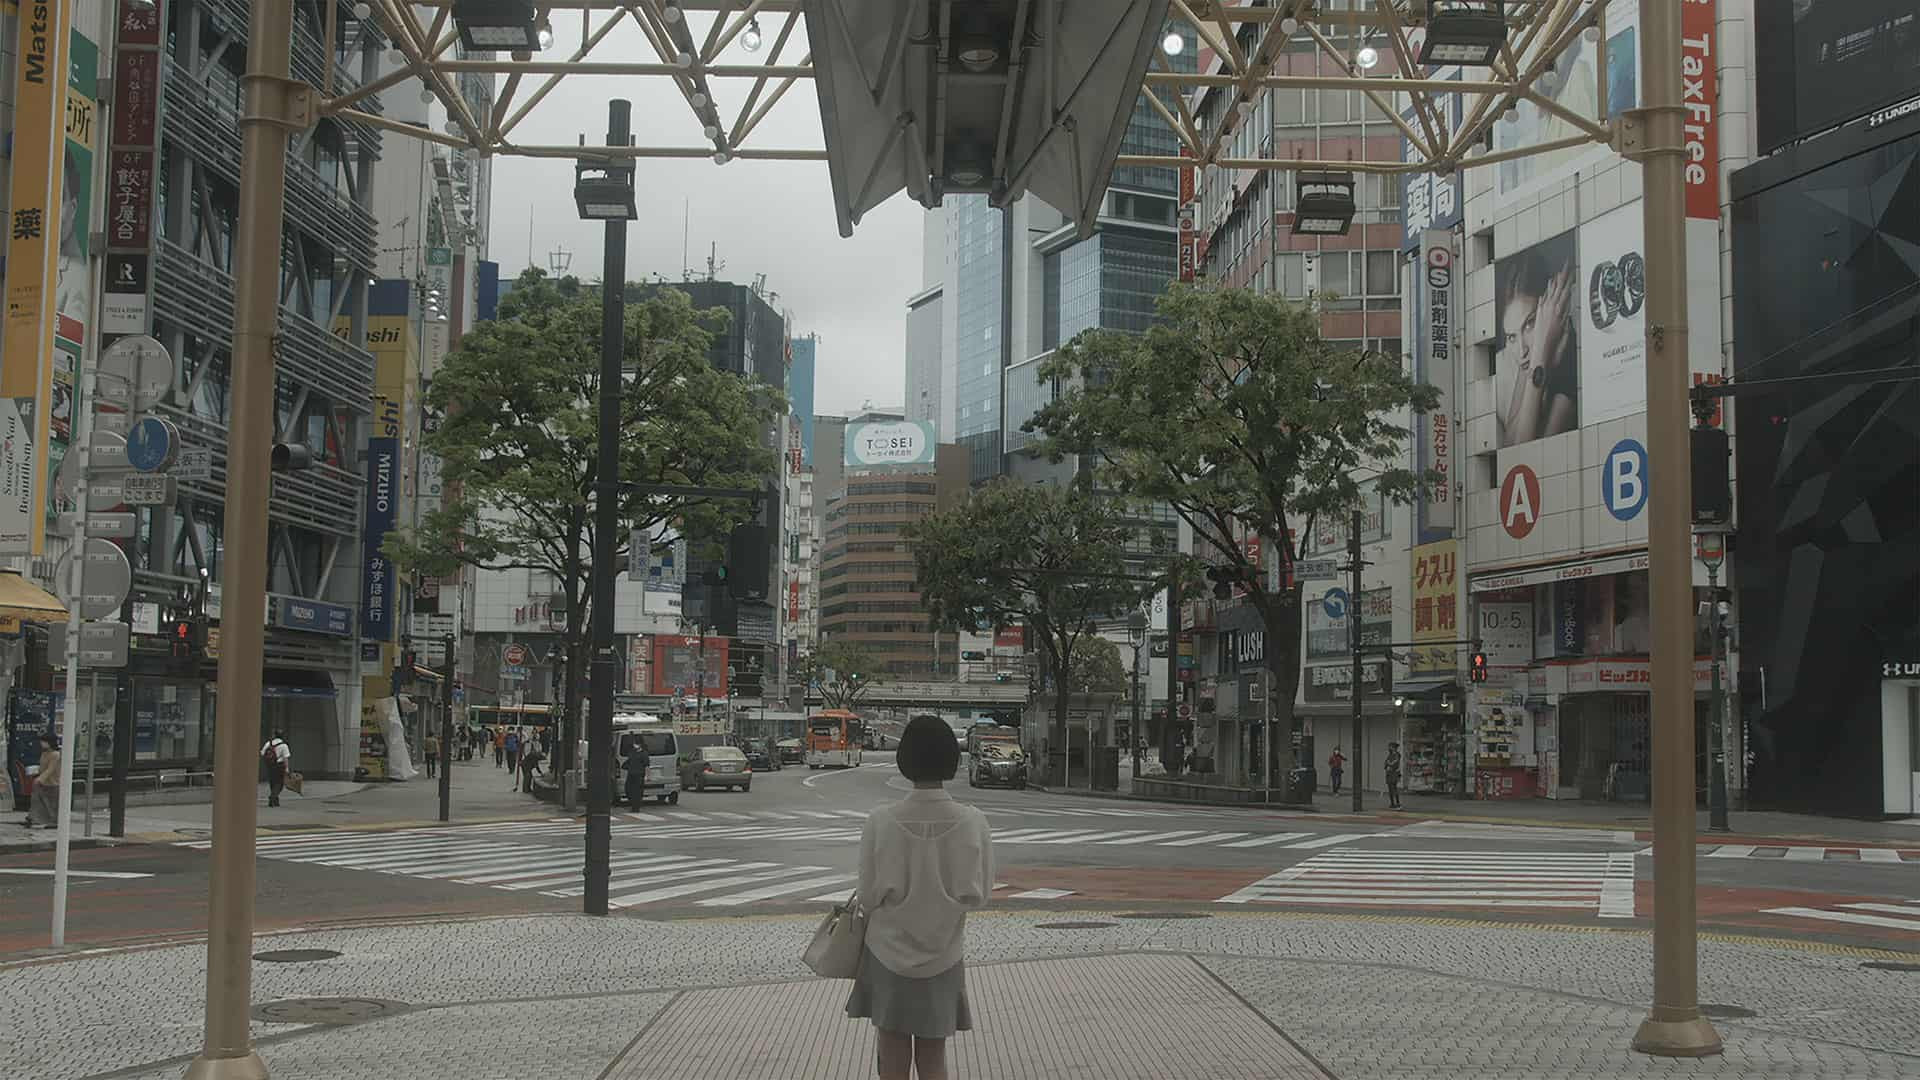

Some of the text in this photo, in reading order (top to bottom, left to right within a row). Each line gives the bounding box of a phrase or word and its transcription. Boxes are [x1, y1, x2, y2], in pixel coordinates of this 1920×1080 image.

[24, 0, 49, 85] Mats
[1682, 33, 1711, 185] TaxFree
[13, 207, 42, 241] 薬
[114, 168, 142, 241] 餃子屋台
[332, 326, 400, 343] Kishi
[1431, 289, 1449, 361] 調剤薬局
[375, 453, 393, 513] MIZUHO
[1506, 472, 1534, 527] A
[1611, 450, 1643, 512] B
[368, 557, 385, 622] みずほ銀行
[1415, 551, 1456, 590] クスリ
[1237, 631, 1265, 664] LUSH
